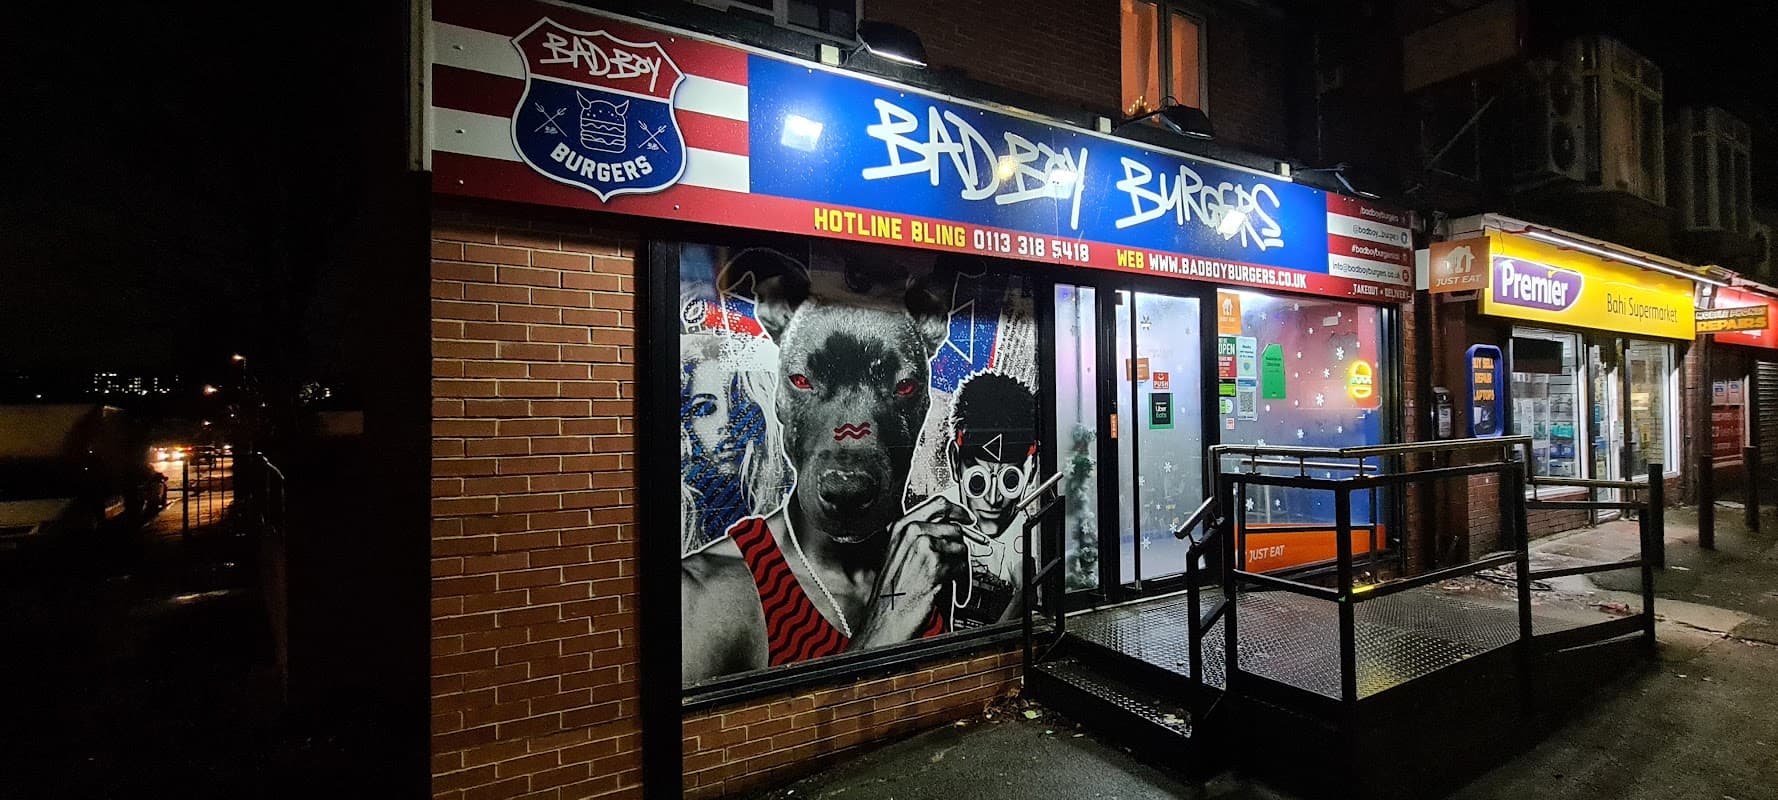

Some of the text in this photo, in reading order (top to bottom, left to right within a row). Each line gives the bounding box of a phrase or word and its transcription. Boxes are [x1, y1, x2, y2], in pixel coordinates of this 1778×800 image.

[540, 32, 610, 76] BAD
[550, 142, 653, 182] BURGERS
[862, 98, 1000, 201] BAD
[1115, 156, 1285, 251] BURGERS
[814, 207, 1307, 289] HOTLINE BLING 0113 318 5418 WEB WWW.BADBOYBURGERS.CO.UK
[1435, 274, 1482, 287] JUST EAT
[1501, 260, 1569, 307] Premier
[1353, 284, 1378, 296] TAKEOUT
[1607, 293, 1678, 323] Bahi Supermarket
[1696, 316, 1767, 332] REPAIRS
[1218, 344, 1236, 355] OPEN
[1475, 372, 1492, 384] REPAIR
[1474, 389, 1495, 401] LAPTOPS
[1250, 545, 1285, 562] JUST EAT
